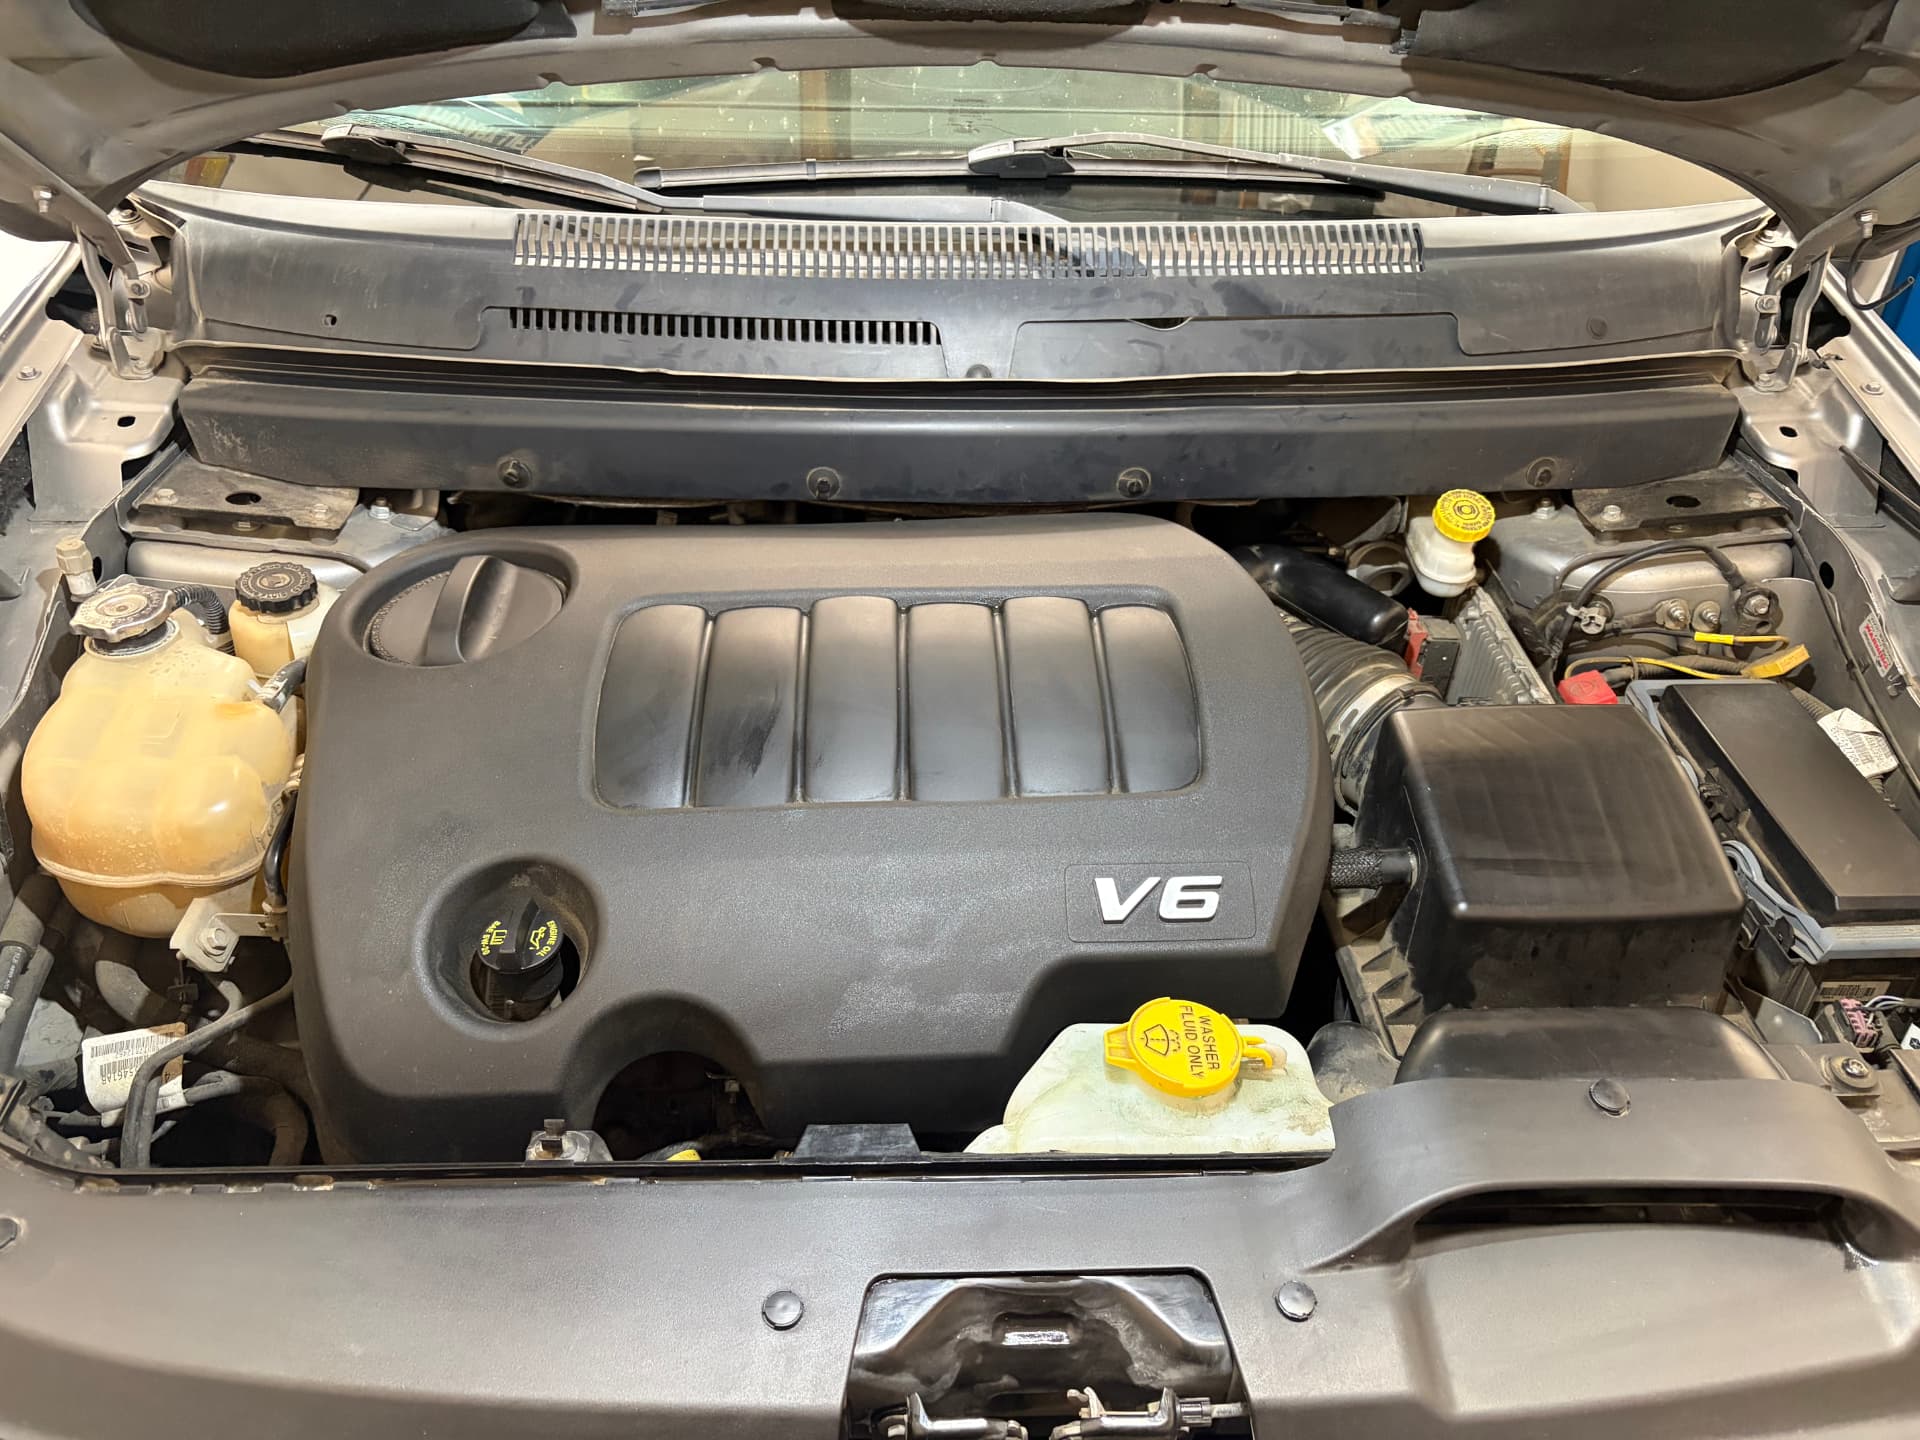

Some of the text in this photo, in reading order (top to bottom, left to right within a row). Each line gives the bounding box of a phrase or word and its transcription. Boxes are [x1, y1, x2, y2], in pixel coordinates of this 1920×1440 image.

[1093, 875, 1222, 923] V6
[536, 946, 551, 957] OIL
[546, 920, 558, 945] ENGINE
[1180, 1005, 1205, 1079] FLUID ONLY
[1199, 1015, 1220, 1070] WASHER
